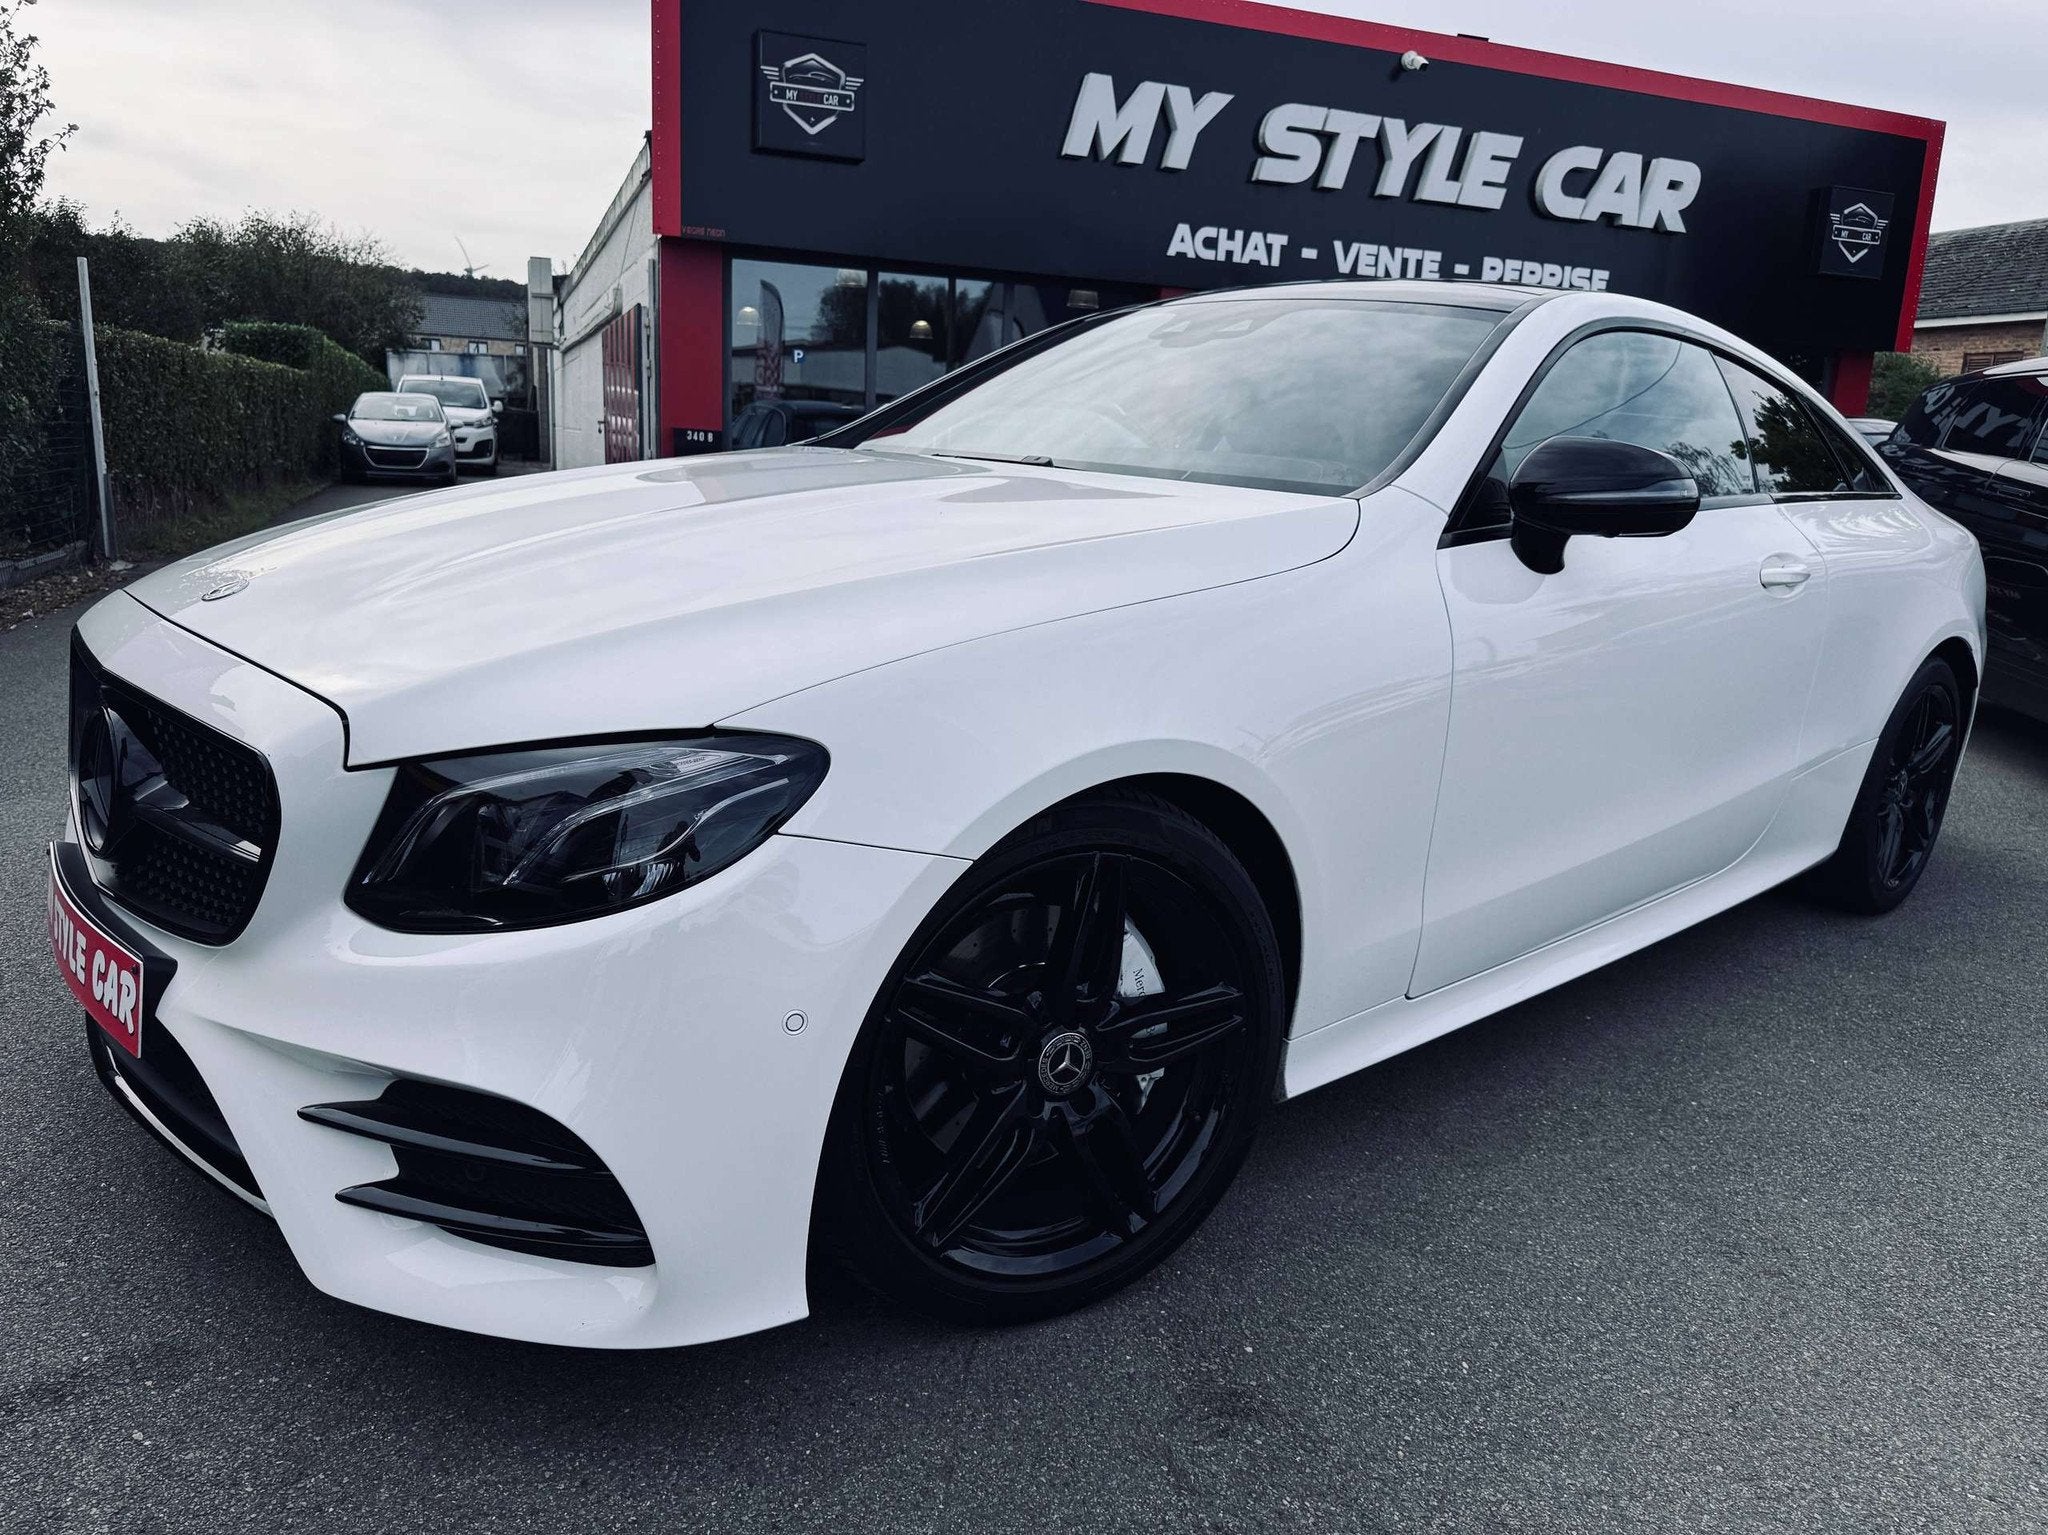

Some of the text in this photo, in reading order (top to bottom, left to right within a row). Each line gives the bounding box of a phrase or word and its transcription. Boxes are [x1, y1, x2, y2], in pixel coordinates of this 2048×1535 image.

[785, 89, 798, 101] MY
[823, 94, 839, 106] CAR
[1061, 72, 1702, 233] MY STYLE CAR
[1166, 223, 1289, 267] ACHAT
[1333, 240, 1442, 280] VENTE
[686, 430, 705, 442] 340
[92, 949, 137, 1035] CAR
